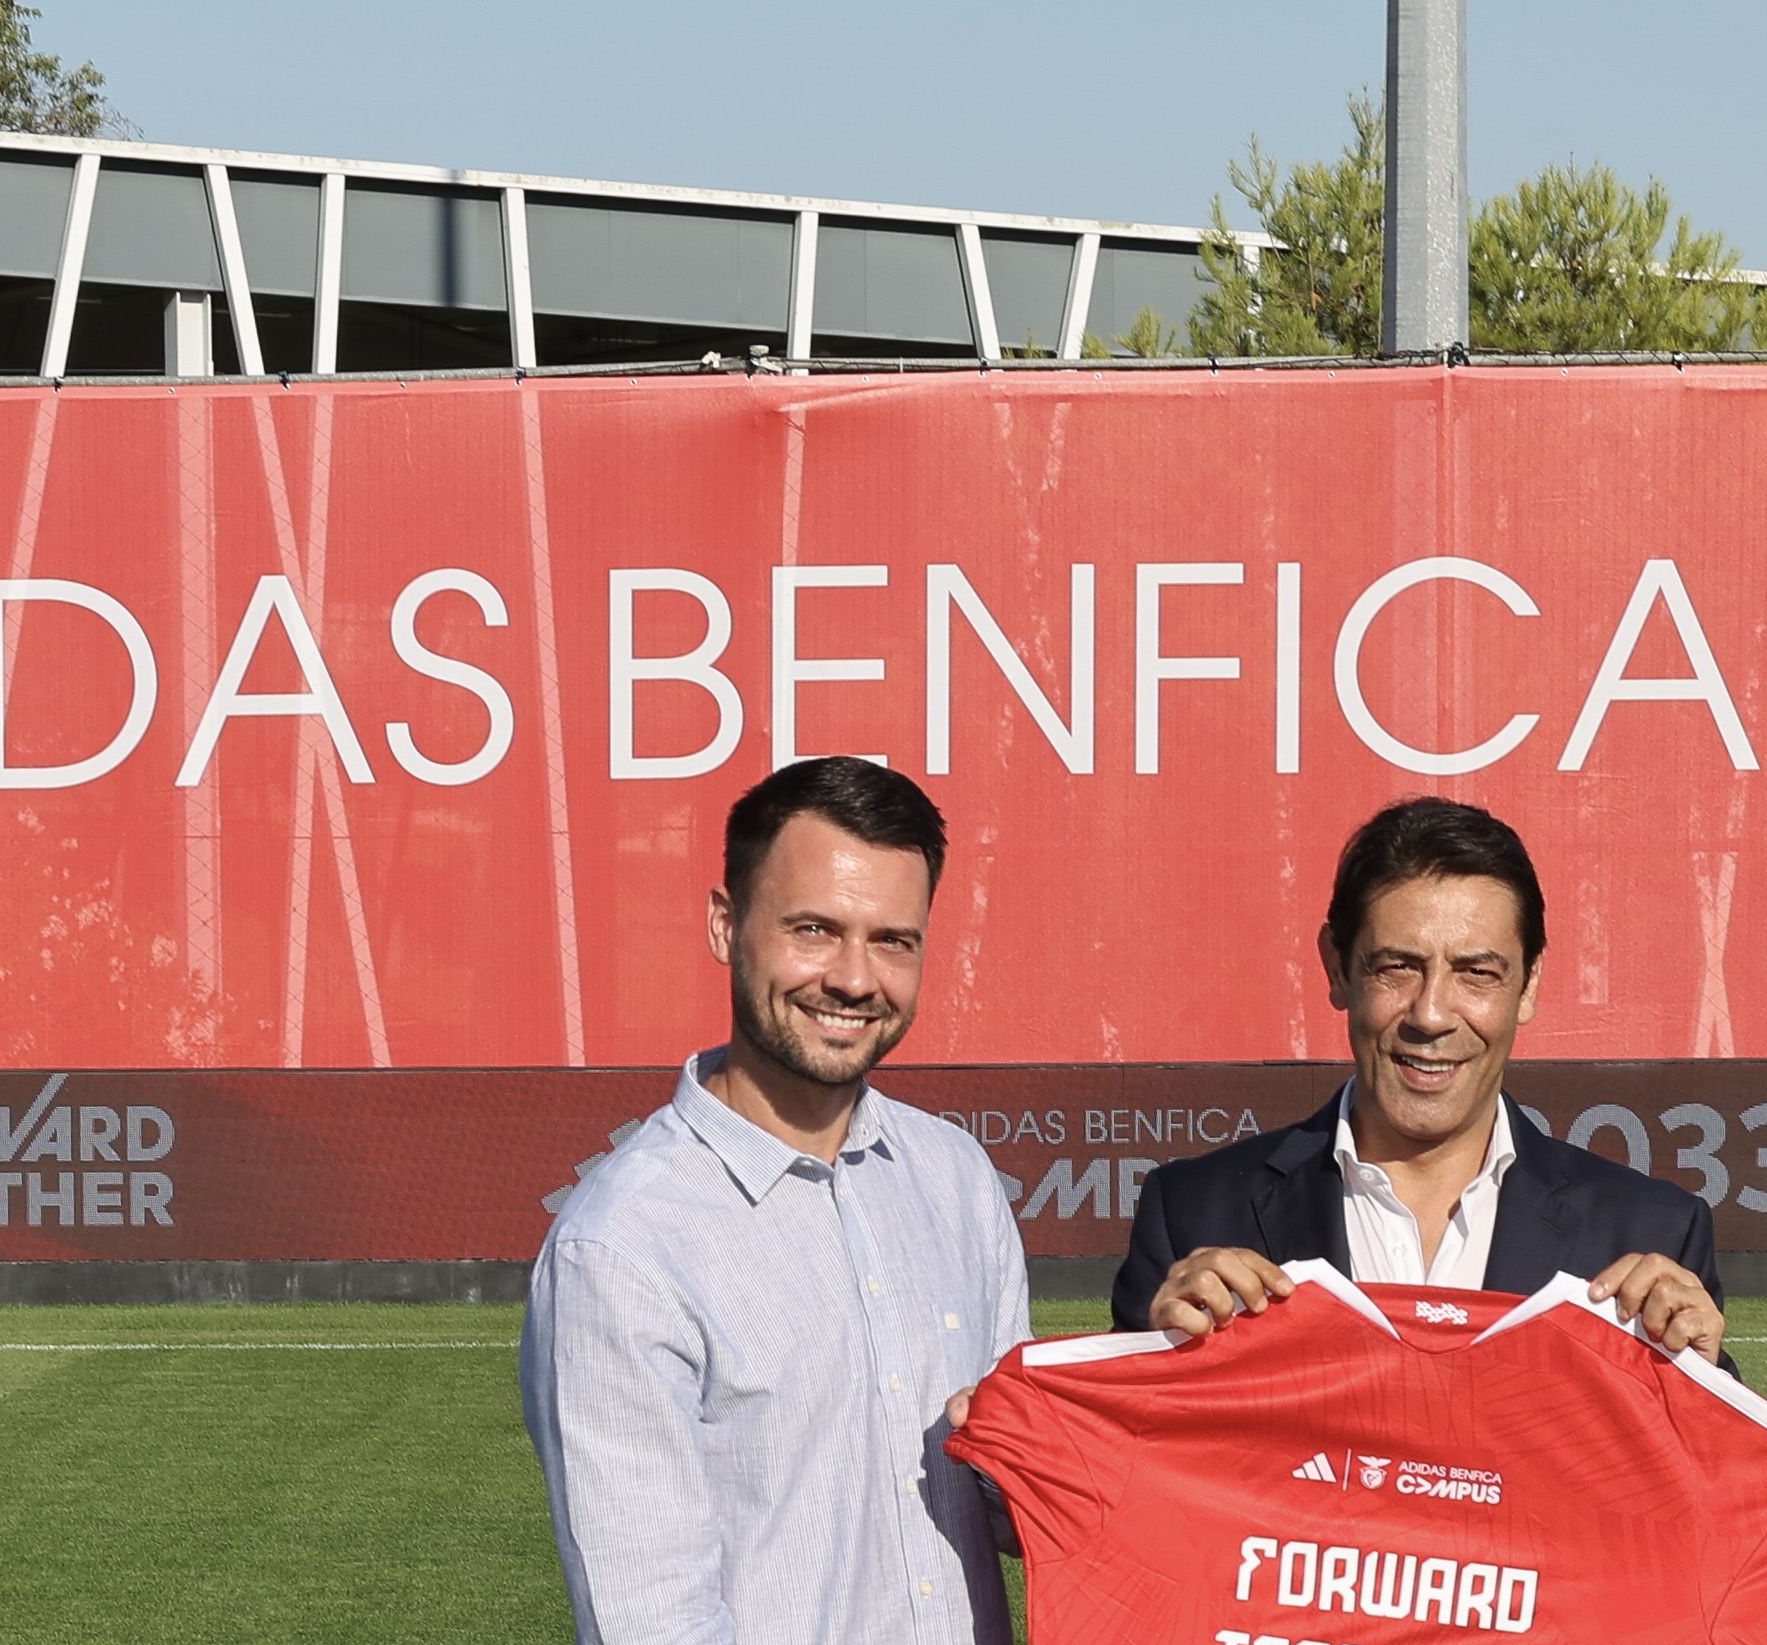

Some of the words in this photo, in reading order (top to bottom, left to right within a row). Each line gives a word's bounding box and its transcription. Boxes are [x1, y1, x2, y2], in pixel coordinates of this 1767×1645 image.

[608, 556, 1760, 779] BENFICA
[1084, 1107, 1261, 1145] BENFICA
[1398, 1460, 1447, 1478] ADIDAS
[1449, 1468, 1503, 1485] BENFICA
[1235, 1537, 1539, 1634] FORWARD
